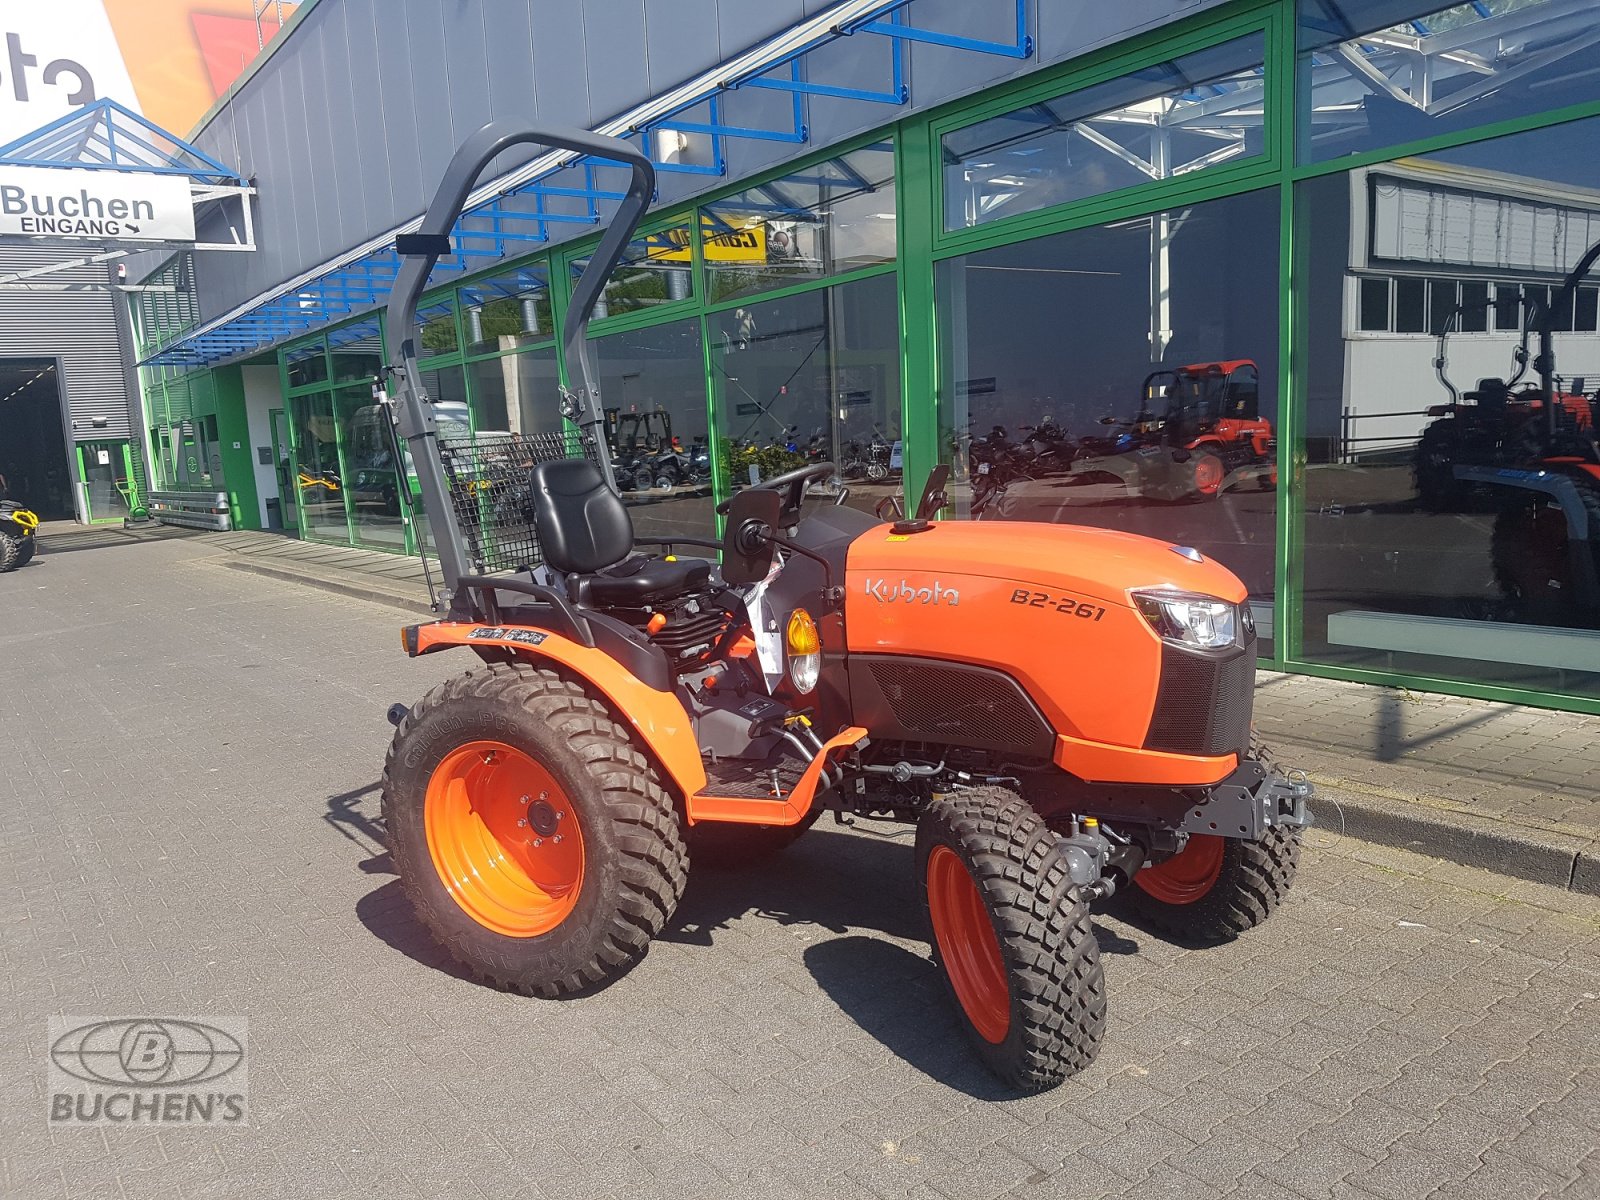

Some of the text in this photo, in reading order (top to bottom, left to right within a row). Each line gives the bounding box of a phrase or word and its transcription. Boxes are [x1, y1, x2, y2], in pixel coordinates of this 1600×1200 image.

[0, 184, 155, 221] Buchen
[20, 217, 120, 235] EINGANG
[865, 578, 960, 606] Kubota
[1009, 589, 1106, 622] B2-261
[404, 715, 464, 769] Garden
